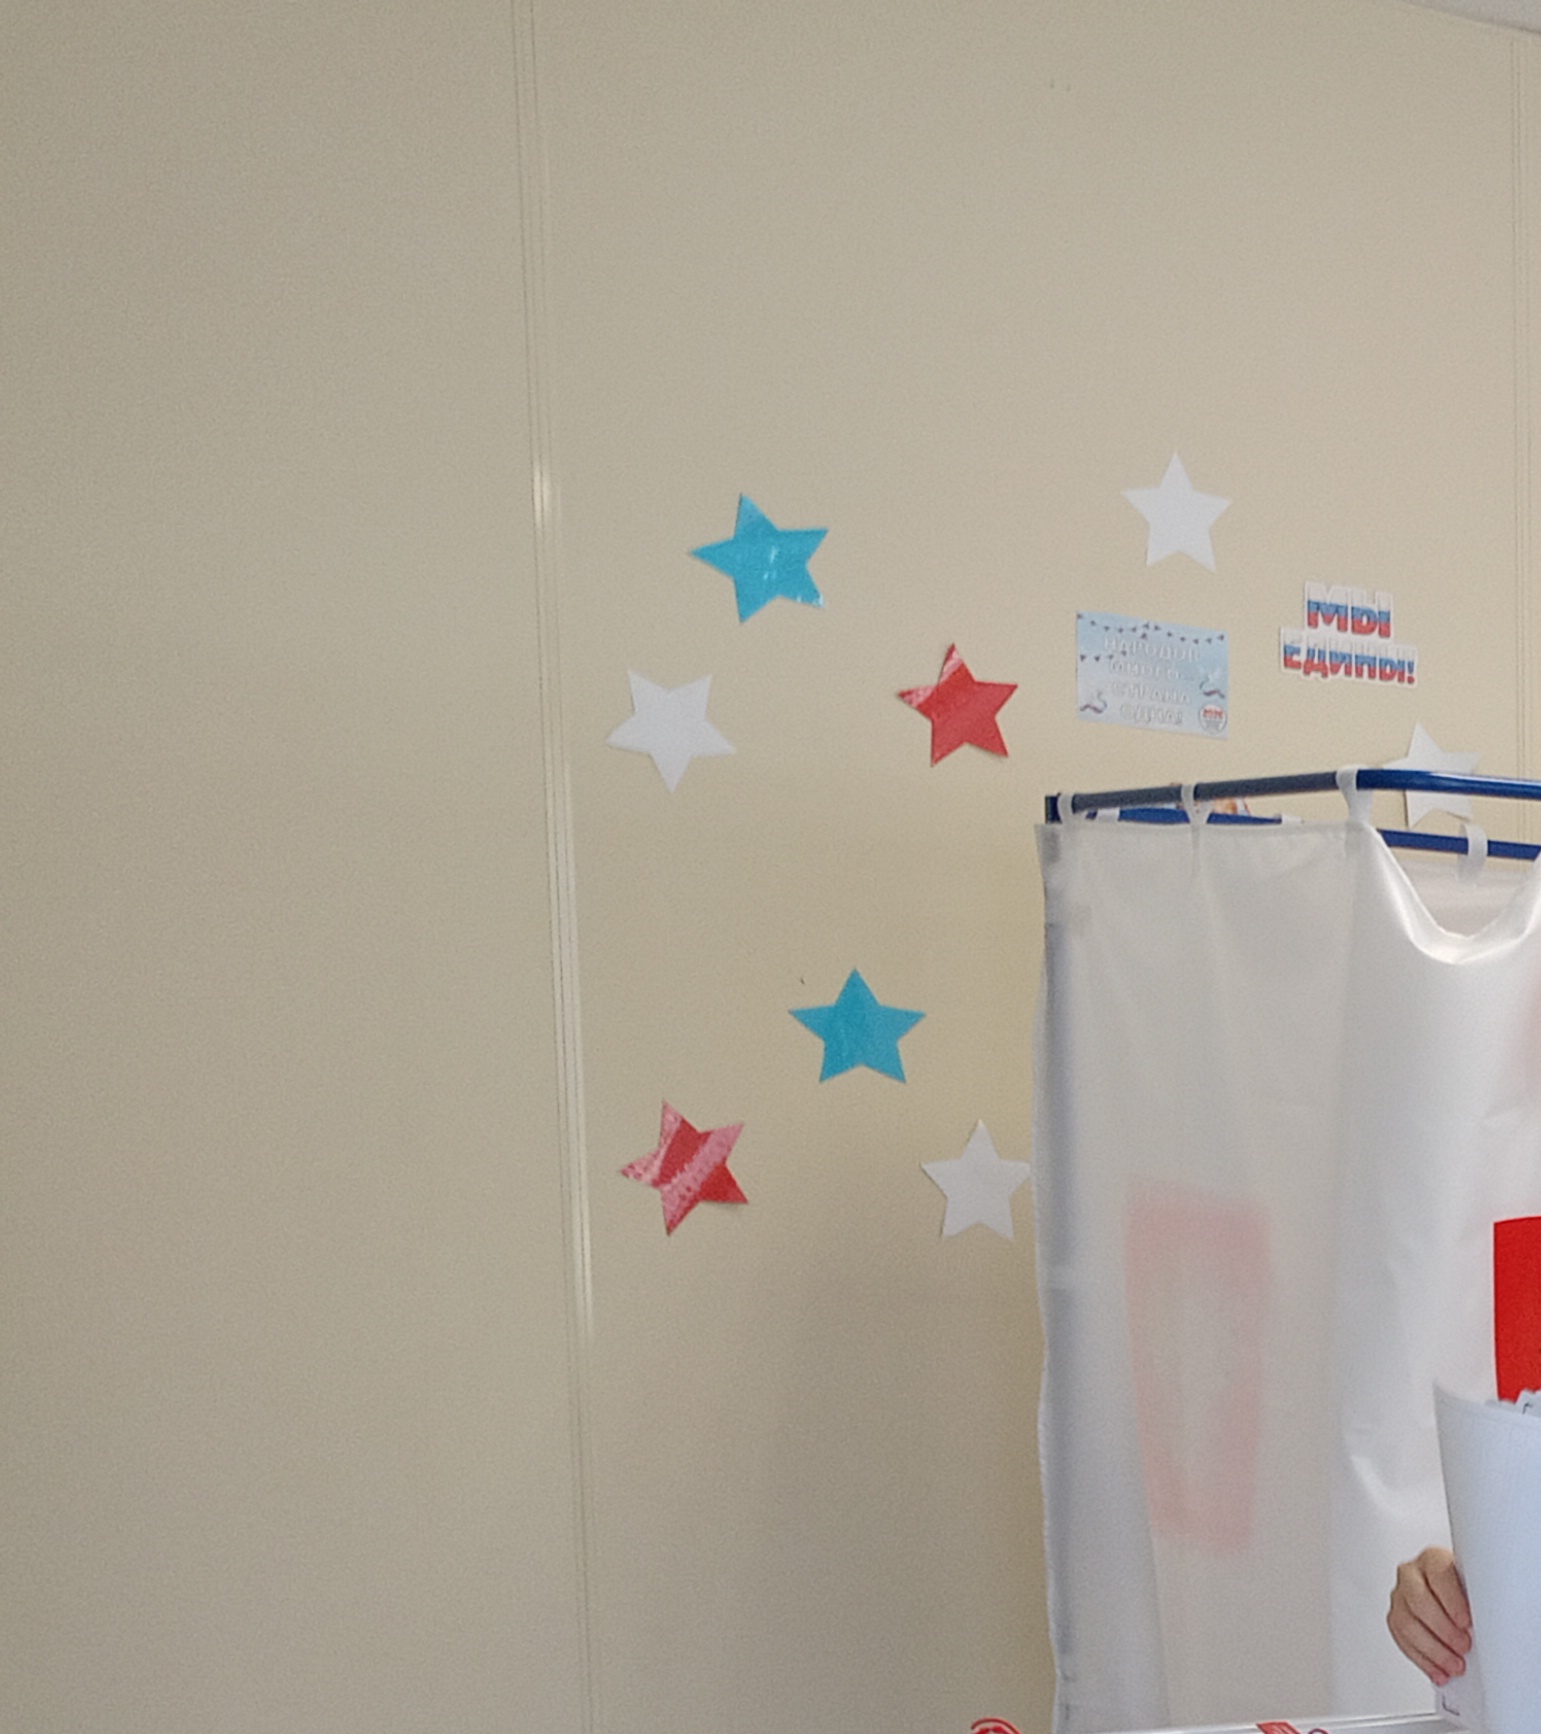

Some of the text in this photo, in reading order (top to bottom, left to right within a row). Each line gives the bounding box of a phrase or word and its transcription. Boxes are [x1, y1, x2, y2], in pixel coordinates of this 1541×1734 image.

[1306, 582, 1392, 638] МЫ
[1283, 632, 1415, 684] ЕДИНЫ!
[1112, 681, 1191, 706] СТРАНА
[1120, 704, 1184, 728] ОДНА!
